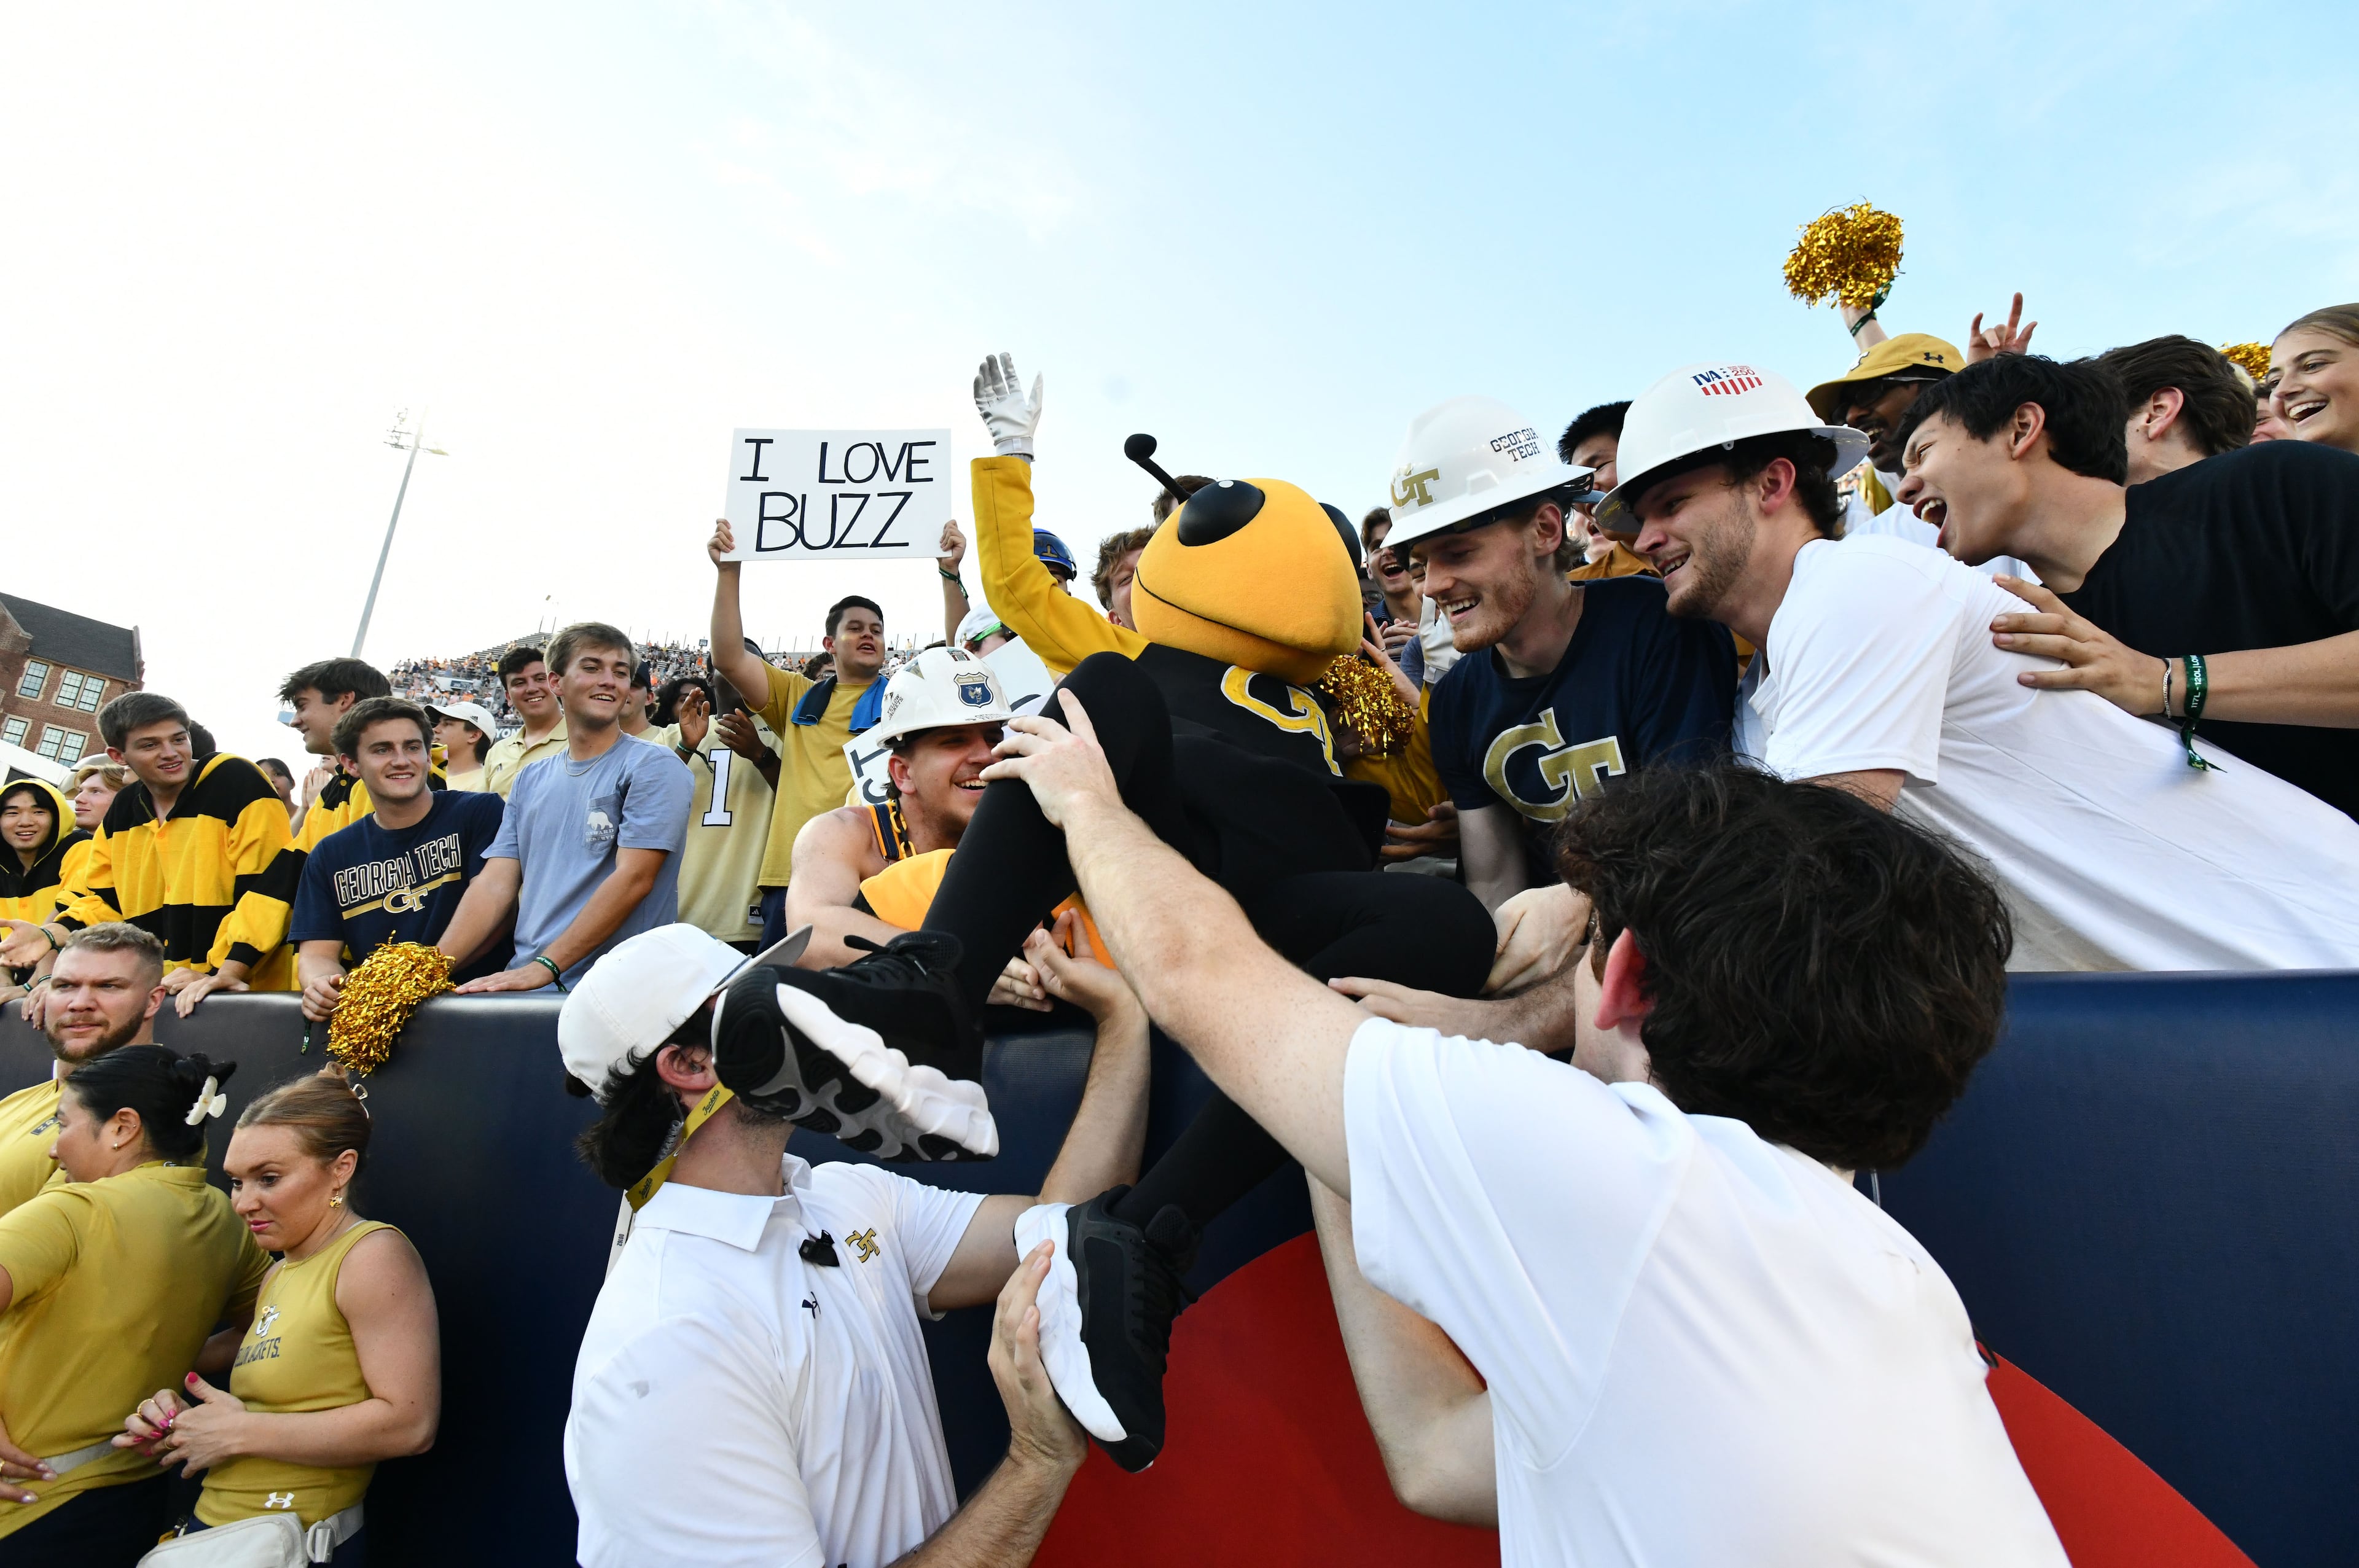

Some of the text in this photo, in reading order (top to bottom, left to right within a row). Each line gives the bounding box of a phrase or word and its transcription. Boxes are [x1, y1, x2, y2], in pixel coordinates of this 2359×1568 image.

[1690, 370, 1722, 386] TVA
[1490, 427, 1539, 453] GEORGIA
[1507, 442, 1540, 462] TECH
[740, 439, 936, 483] I LOVE
[755, 491, 913, 552] BUZZ
[2191, 692, 2201, 708] 117L
[1483, 707, 1626, 824] GT
[702, 748, 733, 827] 1
[334, 833, 461, 907] GEORGIA TECH
[383, 886, 428, 913] GT
[702, 1090, 720, 1115] Jackets
